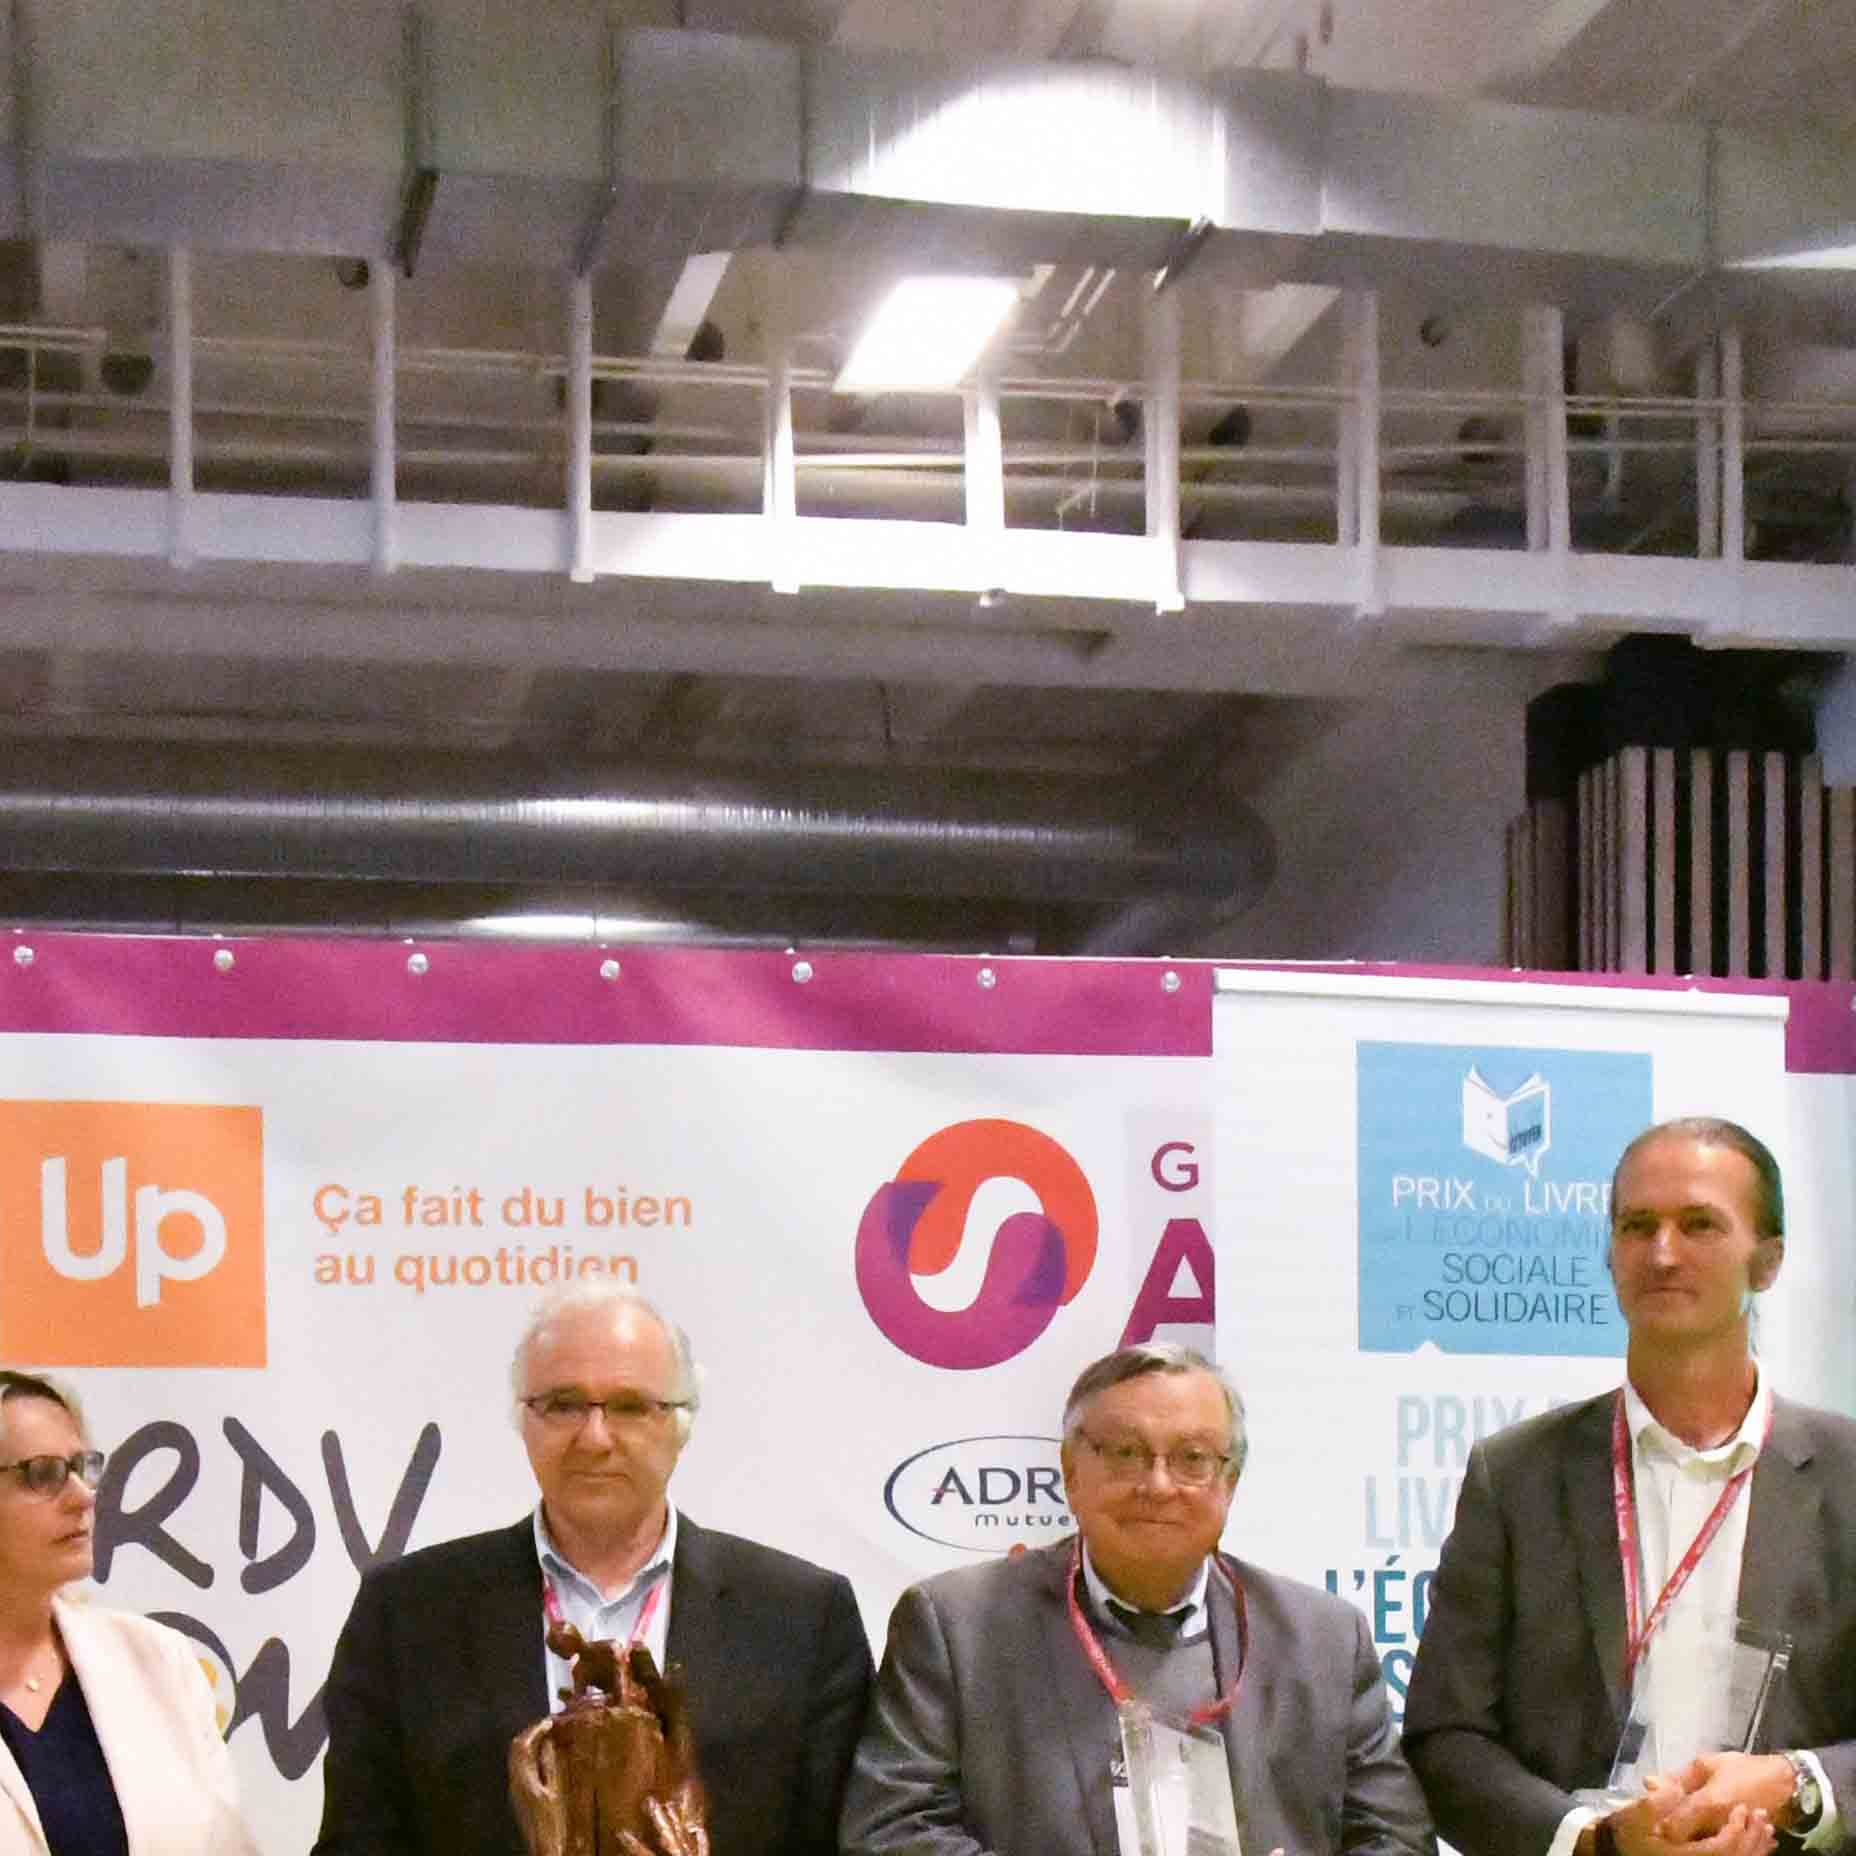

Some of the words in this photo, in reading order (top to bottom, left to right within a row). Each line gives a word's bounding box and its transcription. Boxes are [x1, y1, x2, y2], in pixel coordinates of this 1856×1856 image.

[313, 1183, 384, 1237] Ça
[402, 1184, 485, 1228] fait
[500, 1186, 566, 1228] du
[584, 1184, 694, 1228] bien
[1391, 1175, 1475, 1211] PRIX
[41, 1155, 227, 1307] Up
[313, 1252, 376, 1286] au
[394, 1243, 639, 1295] quotidien
[1442, 1252, 1593, 1288] SOCIALE
[1422, 1288, 1610, 1326] SOLIDAIRE
[930, 1466, 1066, 1505] ADR
[91, 1419, 443, 1595] RDV
[974, 1512, 1071, 1528] mutue
